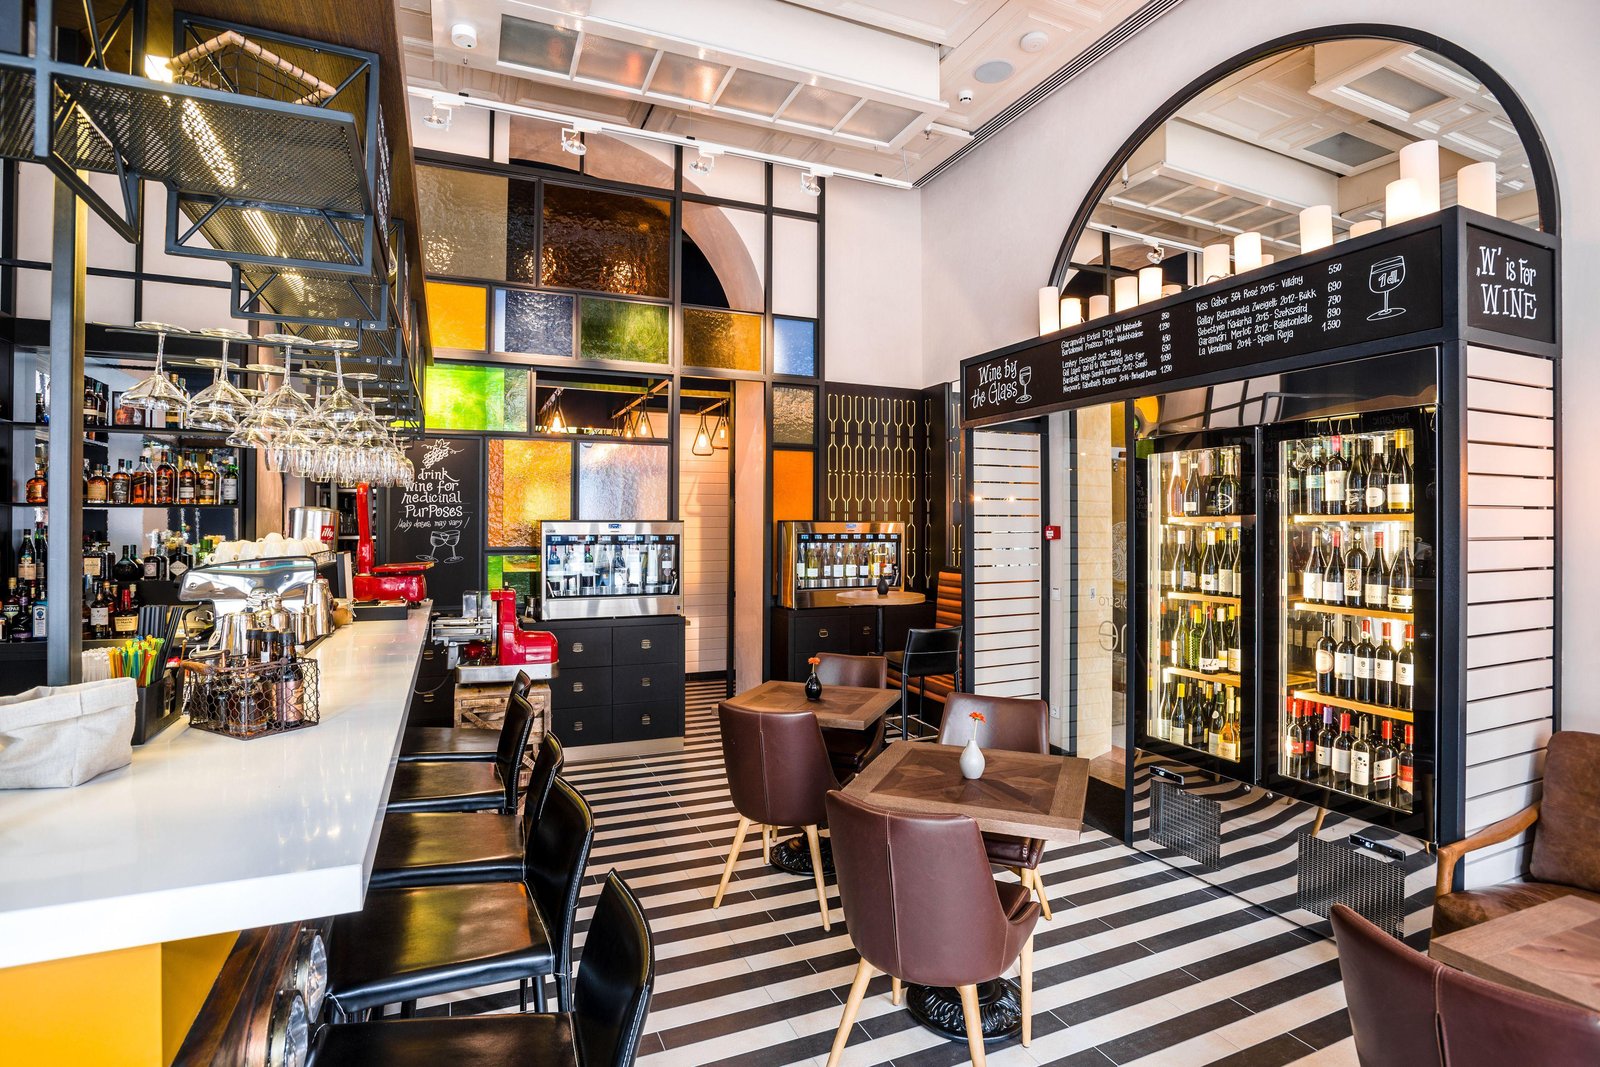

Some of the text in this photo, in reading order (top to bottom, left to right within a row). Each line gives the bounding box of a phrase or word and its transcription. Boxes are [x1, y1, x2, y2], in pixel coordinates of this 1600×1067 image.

[1506, 257, 1515, 281] is
[1196, 301, 1208, 312] Kiss
[1244, 288, 1258, 298] Rosé
[1282, 276, 1303, 288] Villány
[1328, 263, 1342, 274] 550
[1197, 314, 1214, 326] Gallay
[1252, 298, 1277, 311] Zweigelt
[1328, 281, 1341, 292] 690
[1328, 295, 1341, 307] 790
[1481, 284, 1537, 319] WINE
[1103, 329, 1113, 337] Dry
[1231, 327, 1251, 339] Merlot
[1327, 308, 1341, 318] 890
[1199, 346, 1205, 355] La
[1208, 341, 1232, 354] Vendimia
[1277, 329, 1293, 343] Rioja
[978, 359, 1017, 386] Wine by
[970, 381, 1018, 408] the Glass
[418, 468, 460, 481] drink
[401, 491, 462, 504] medicinal
[437, 481, 459, 494] for
[321, 527, 334, 539] illy
[434, 520, 446, 529] may
